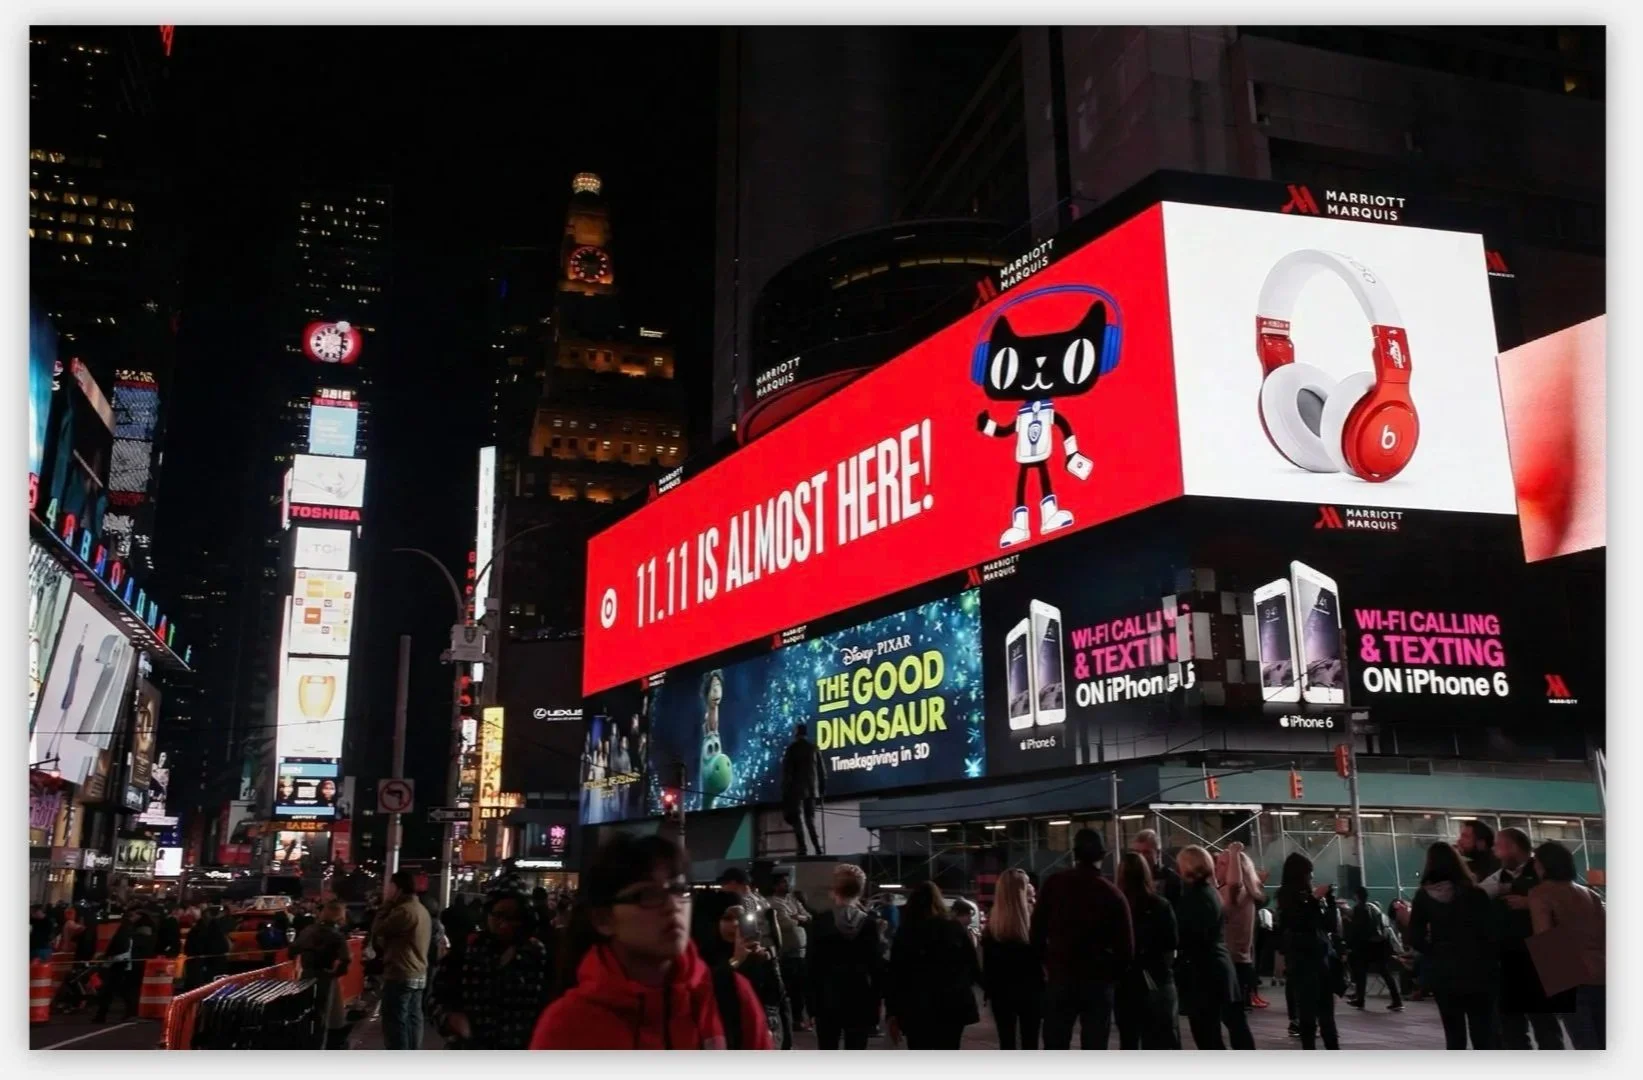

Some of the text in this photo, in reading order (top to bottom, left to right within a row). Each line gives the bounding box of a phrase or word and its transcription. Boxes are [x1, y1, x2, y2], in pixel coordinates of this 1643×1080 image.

[1326, 190, 1406, 208] MARRIOTT
[1327, 205, 1398, 221] MARQUIS
[999, 238, 1055, 279] MARRIOTT
[1000, 256, 1049, 291] MARQUIS
[755, 356, 801, 386] MARRIOTT
[756, 373, 795, 399] MARQUIS
[290, 505, 360, 521] TOSHIBA
[636, 417, 934, 629] 11.11 IS ALMOST HERE!
[1346, 508, 1404, 520] MARRIOTT
[1346, 518, 1399, 530] MARQUIS
[983, 565, 1017, 583] MARQUIS
[1353, 608, 1502, 635] WI-FI CALLING
[877, 635, 912, 656] PIXAR
[1071, 623, 1109, 650] WI-FI
[1360, 633, 1505, 667] & TEXTING
[1074, 629, 1193, 680] & TEXTIN
[816, 650, 944, 706] THE GOOD
[1362, 666, 1510, 698] ON iPhone 6
[1075, 679, 1105, 708] ON
[816, 696, 947, 751] DINOSAUR
[1290, 715, 1334, 729] iPhone 6
[900, 746, 912, 761] in
[914, 742, 931, 760] 3D
[1025, 737, 1051, 750] iPhone
